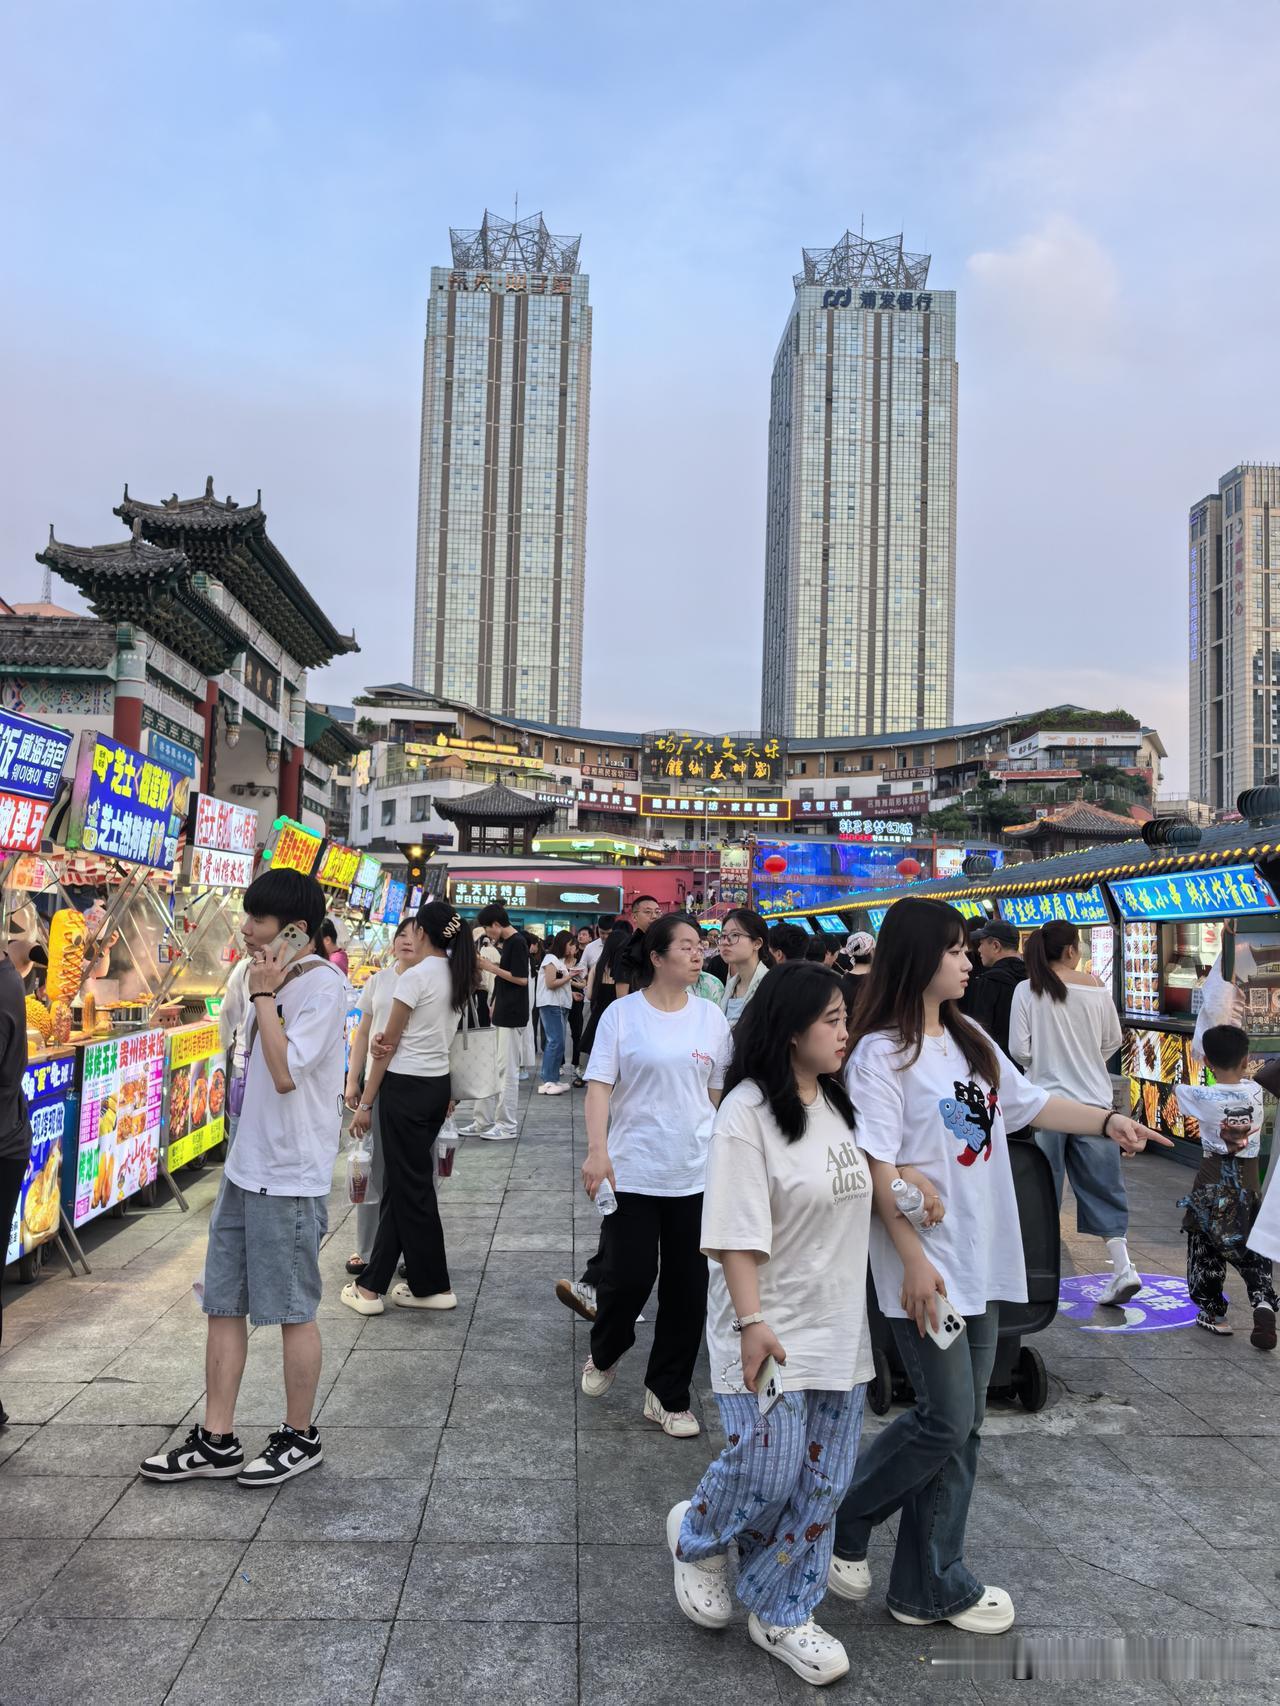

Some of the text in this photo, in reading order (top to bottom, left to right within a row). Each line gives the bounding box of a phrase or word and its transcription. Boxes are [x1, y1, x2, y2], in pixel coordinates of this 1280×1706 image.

[860, 290, 933, 311] 浦发银行
[16, 732, 68, 771] 威海特色
[456, 883, 526, 897] 半天妖烤鱼
[1185, 872, 1259, 911] 韩式炸酱面
[825, 1142, 859, 1173] Adi
[832, 1167, 866, 1196] das
